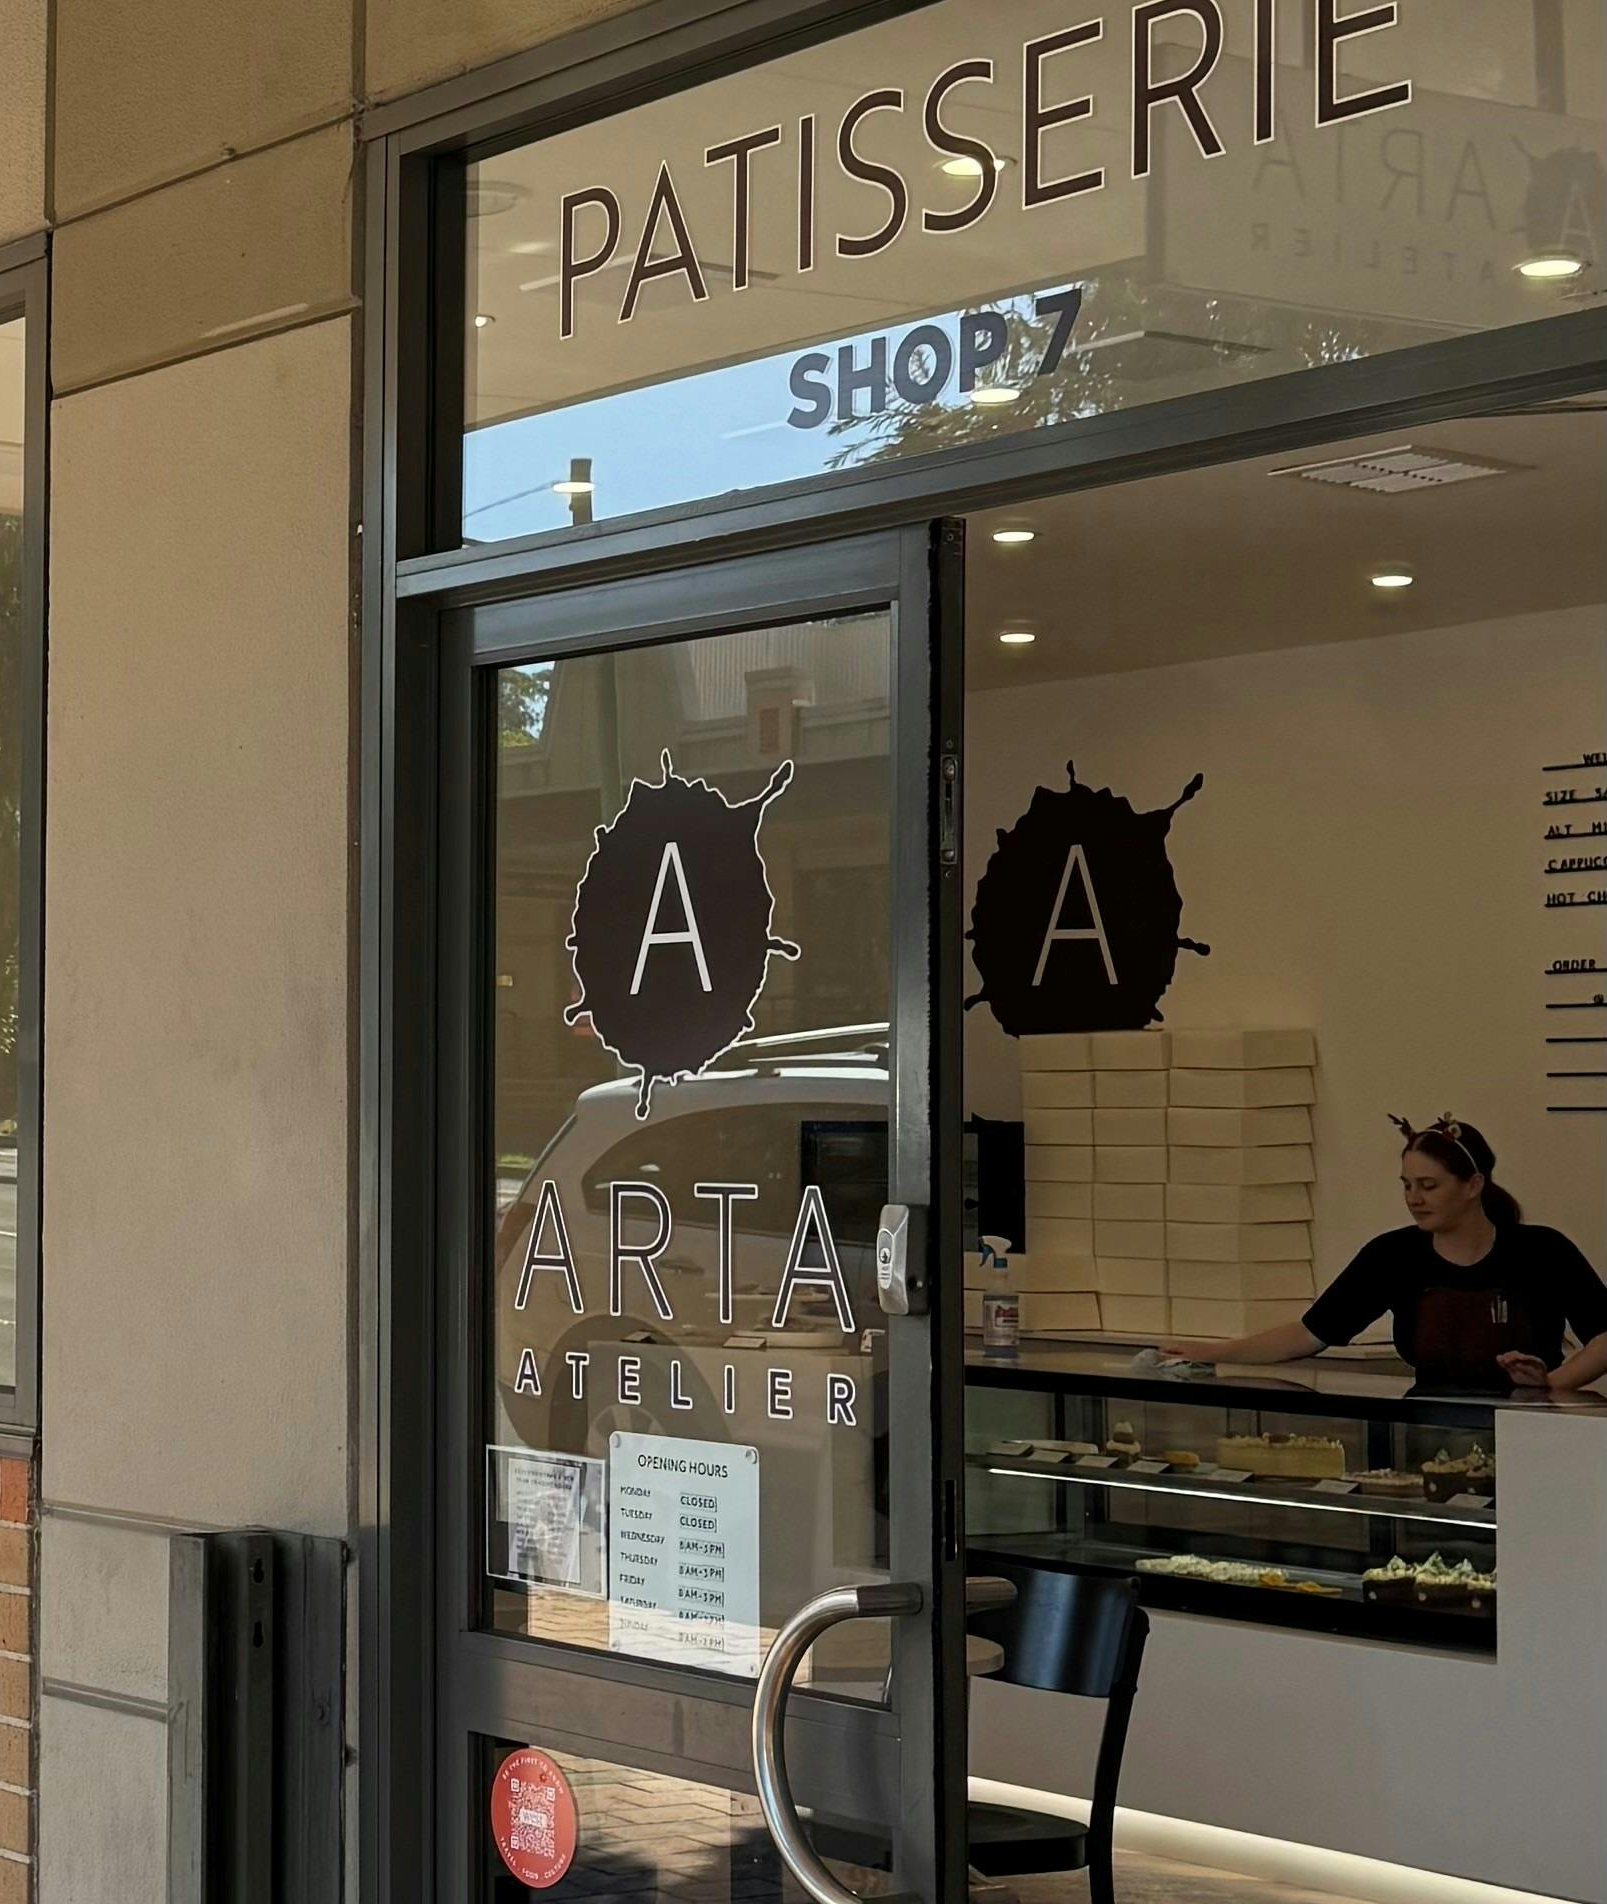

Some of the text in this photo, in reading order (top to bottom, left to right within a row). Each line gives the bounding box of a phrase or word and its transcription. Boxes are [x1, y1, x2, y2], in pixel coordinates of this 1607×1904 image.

[786, 286, 1086, 430] SHOP 7
[1545, 789, 1576, 803] SIZE
[1547, 892, 1575, 905] HOT
[630, 841, 713, 995] A
[1031, 844, 1119, 987] A
[1552, 959, 1595, 972] ORDER
[514, 1179, 857, 1334] ARTA
[514, 1347, 858, 1428] ATELIER
[638, 1454, 728, 1478] OPENING HOURS
[680, 1496, 715, 1509] CLOSED
[680, 1516, 715, 1529] CLOSED
